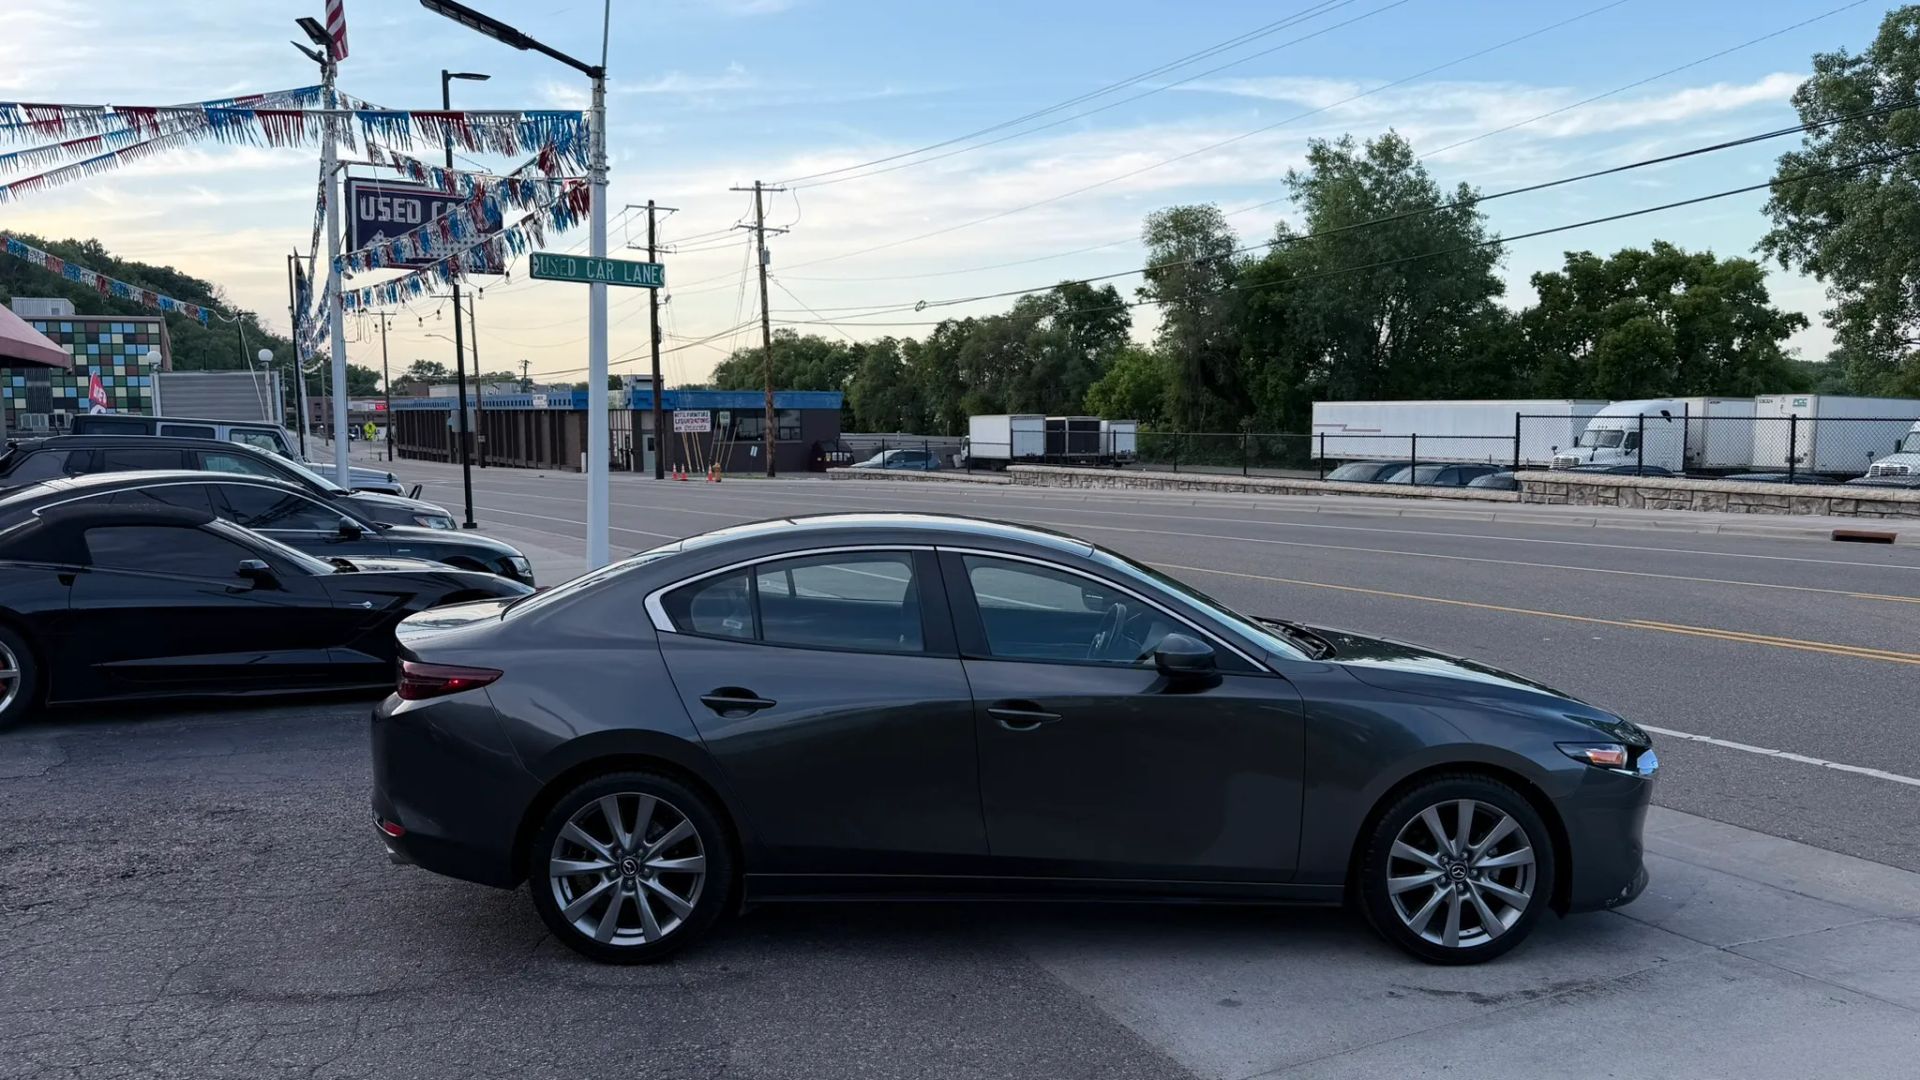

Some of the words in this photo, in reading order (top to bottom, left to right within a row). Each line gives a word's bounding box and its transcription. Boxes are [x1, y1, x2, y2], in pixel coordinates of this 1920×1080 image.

[360, 195, 422, 224] USED
[540, 255, 576, 277] USED
[586, 259, 614, 281] CAR
[623, 263, 659, 284] LANE
